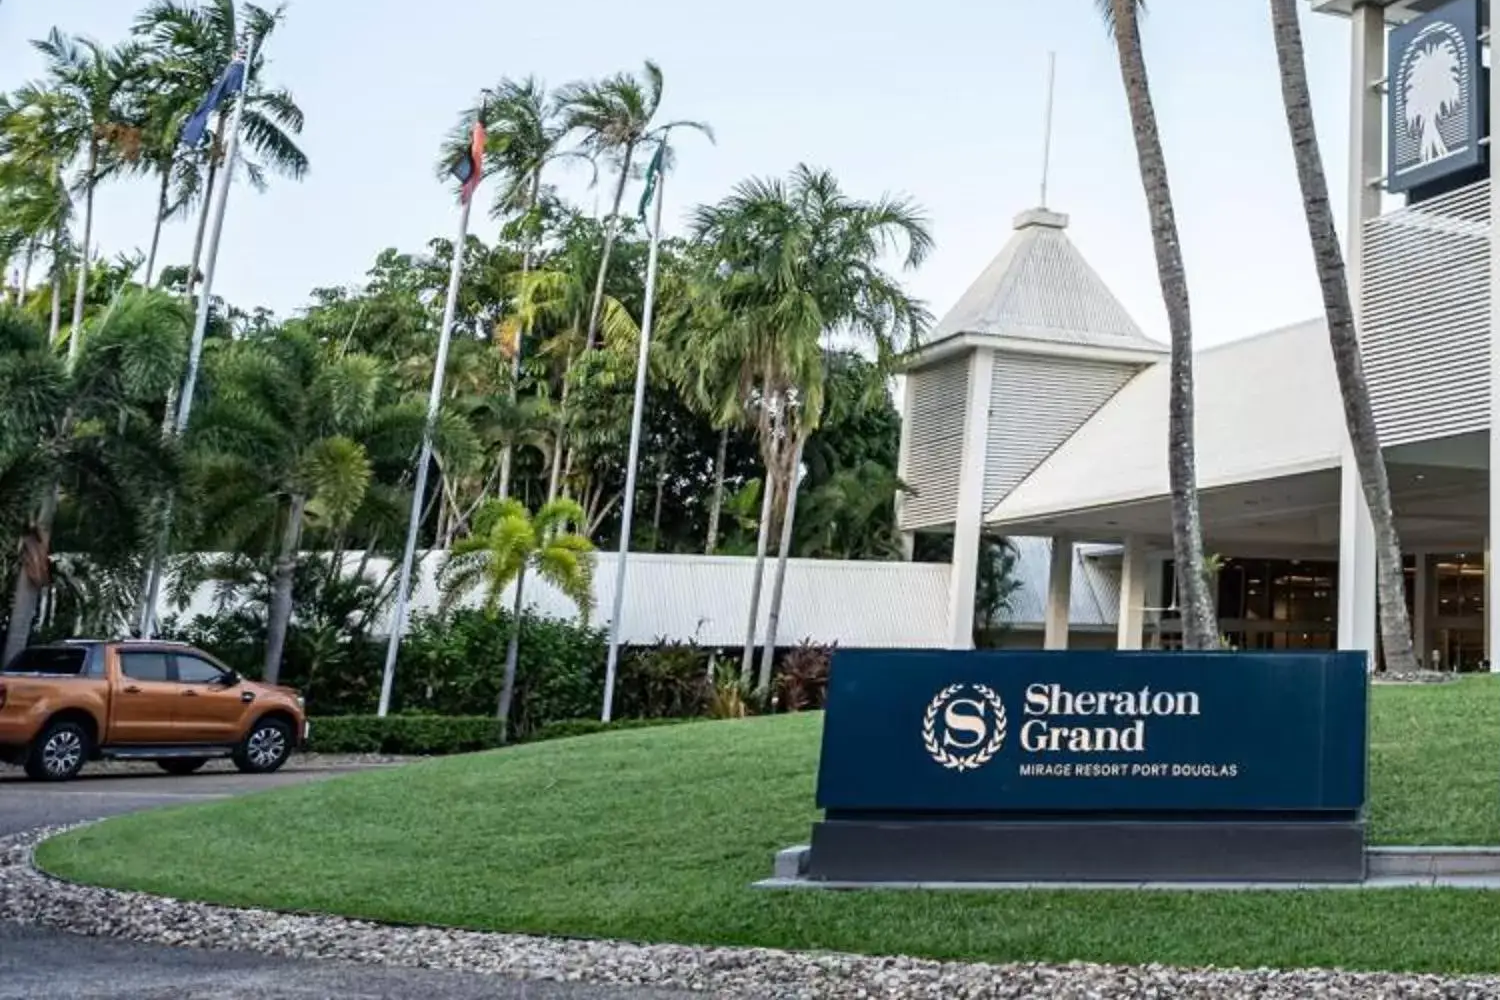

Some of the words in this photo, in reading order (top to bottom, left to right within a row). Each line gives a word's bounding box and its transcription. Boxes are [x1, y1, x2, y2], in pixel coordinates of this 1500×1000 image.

[1023, 683, 1200, 716] Sheraton
[943, 698, 987, 749] S
[1020, 719, 1145, 752] Grand
[1019, 763, 1071, 777] MIRAGE
[1075, 763, 1128, 777] RESORT
[1131, 763, 1168, 777] PORT
[1171, 763, 1238, 777] DOUGLAS
